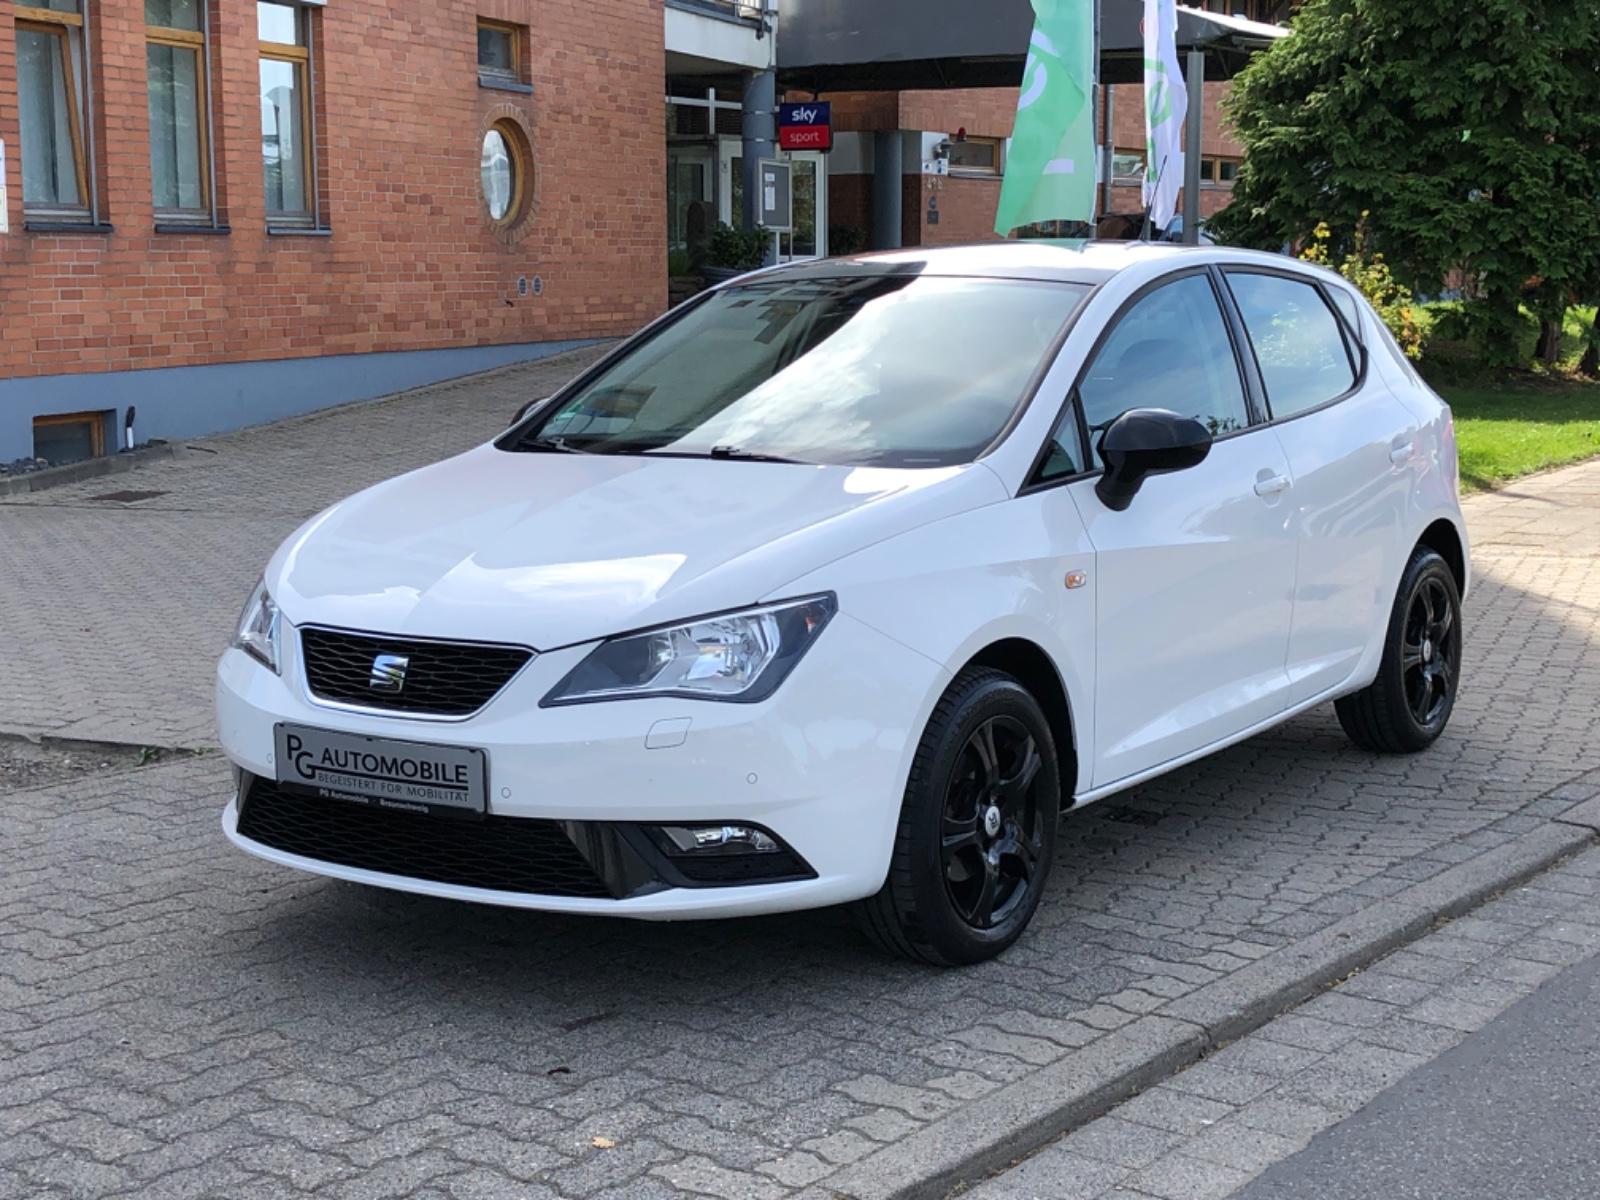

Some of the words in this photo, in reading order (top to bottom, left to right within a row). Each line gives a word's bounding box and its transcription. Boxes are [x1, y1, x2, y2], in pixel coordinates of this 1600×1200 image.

[791, 106, 817, 124] sky
[790, 131, 820, 144] sport
[321, 747, 469, 783] AUTOMOBILE
[318, 772, 376, 791] BEGEISTERT
[406, 785, 470, 802] MOBILITÄT
